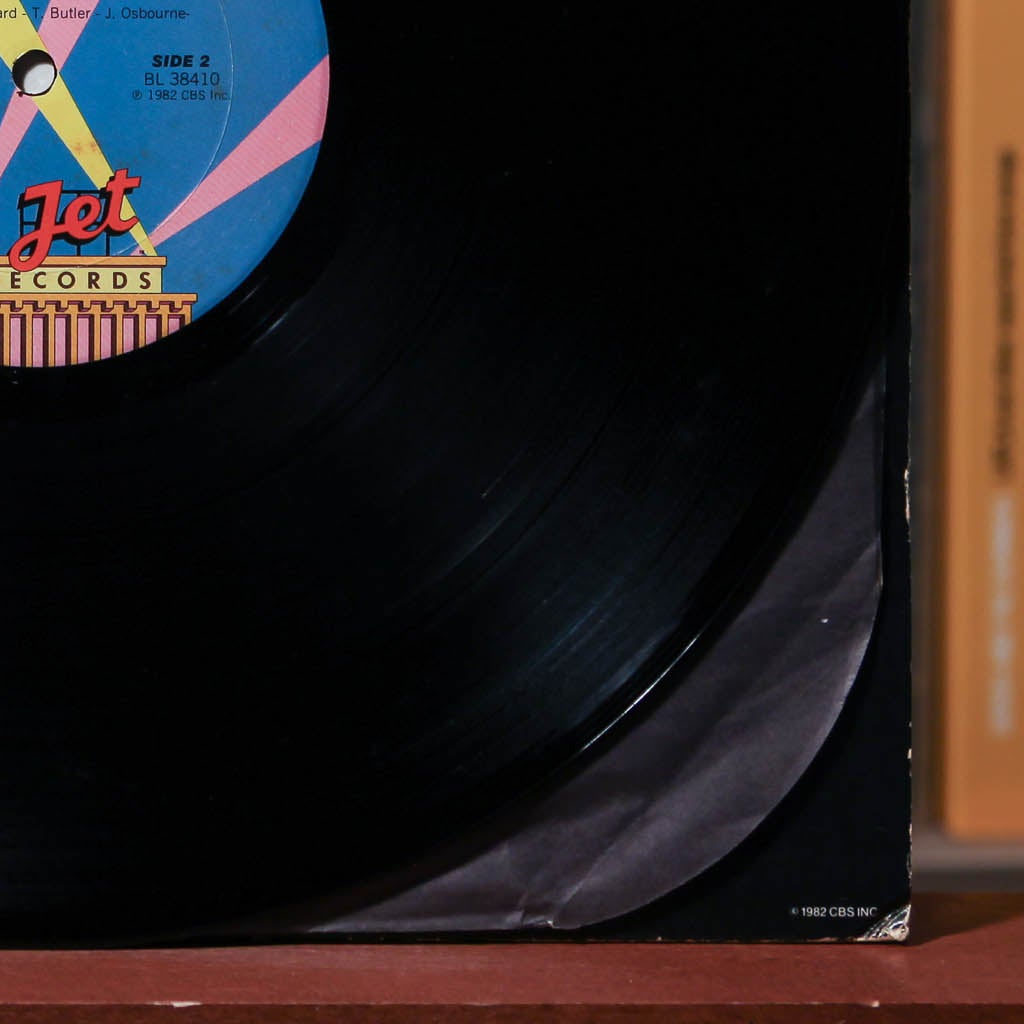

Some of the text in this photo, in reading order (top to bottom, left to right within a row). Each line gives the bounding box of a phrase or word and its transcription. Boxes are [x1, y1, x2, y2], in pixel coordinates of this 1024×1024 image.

[32, 7, 44, 19] T.
[51, 7, 91, 19] Butler
[152, 55, 210, 67] SIDE 2
[144, 72, 220, 85] BL 38410
[149, 90, 177, 100] 1982
[181, 90, 206, 100] CBS
[8, 168, 142, 272] Jet
[801, 907, 827, 917] 1982
[829, 907, 854, 917] CBS
